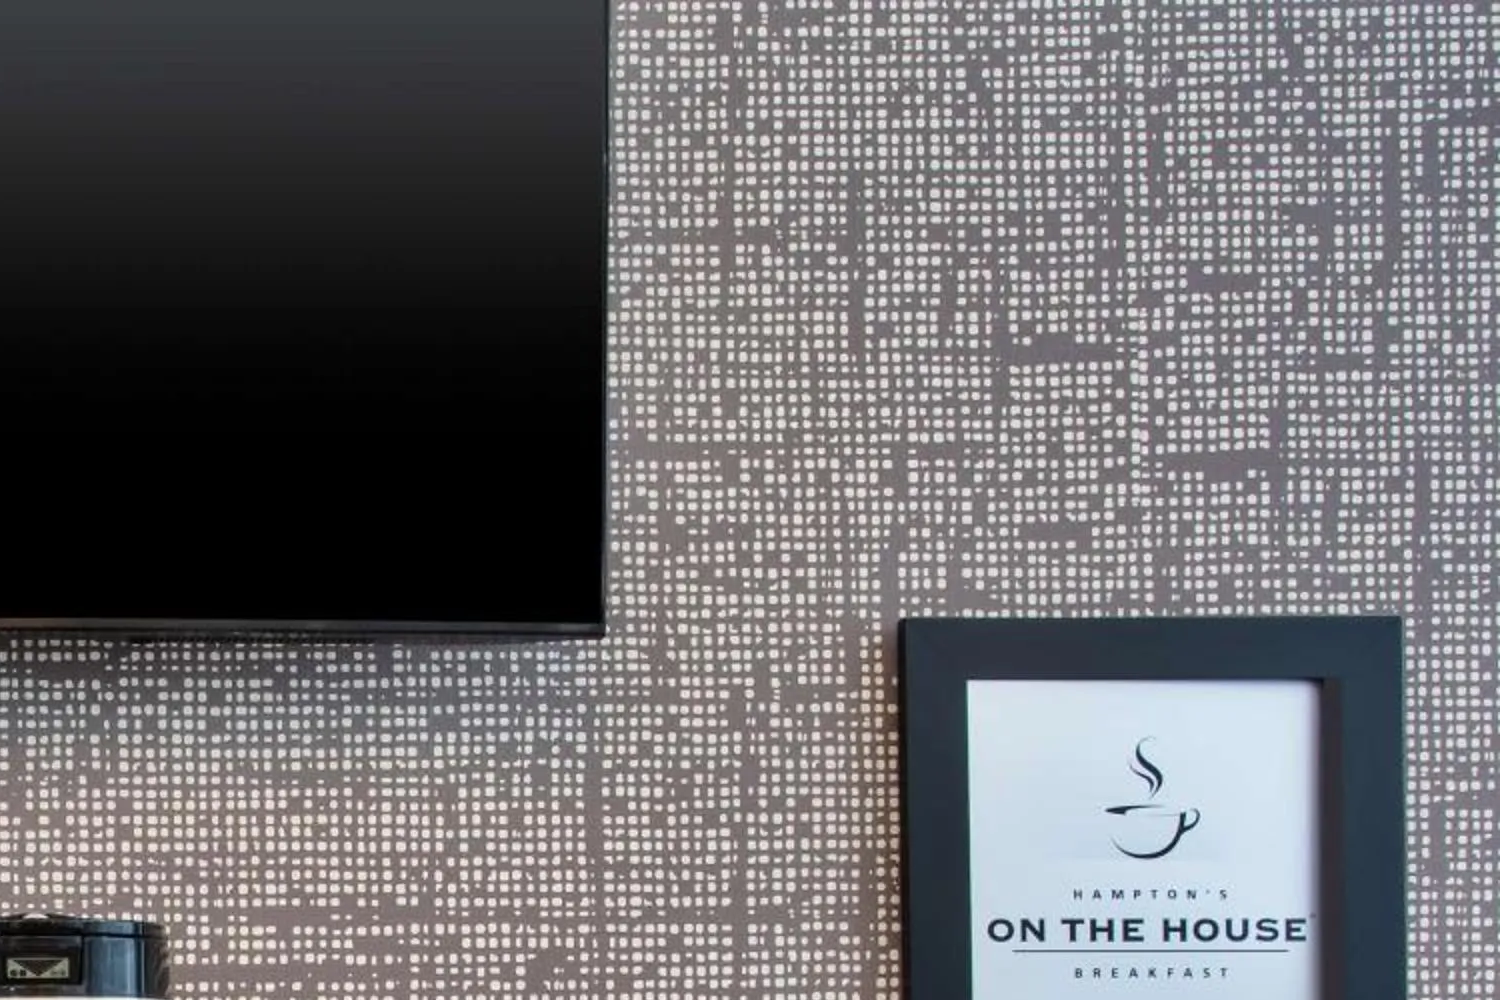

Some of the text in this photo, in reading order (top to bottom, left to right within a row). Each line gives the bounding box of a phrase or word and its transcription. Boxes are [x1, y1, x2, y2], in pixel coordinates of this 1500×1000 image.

[1073, 888, 1229, 901] HAMPTON'S
[987, 917, 1308, 942] ON THE HOUSE
[1074, 966, 1229, 979] BREAKFAST
